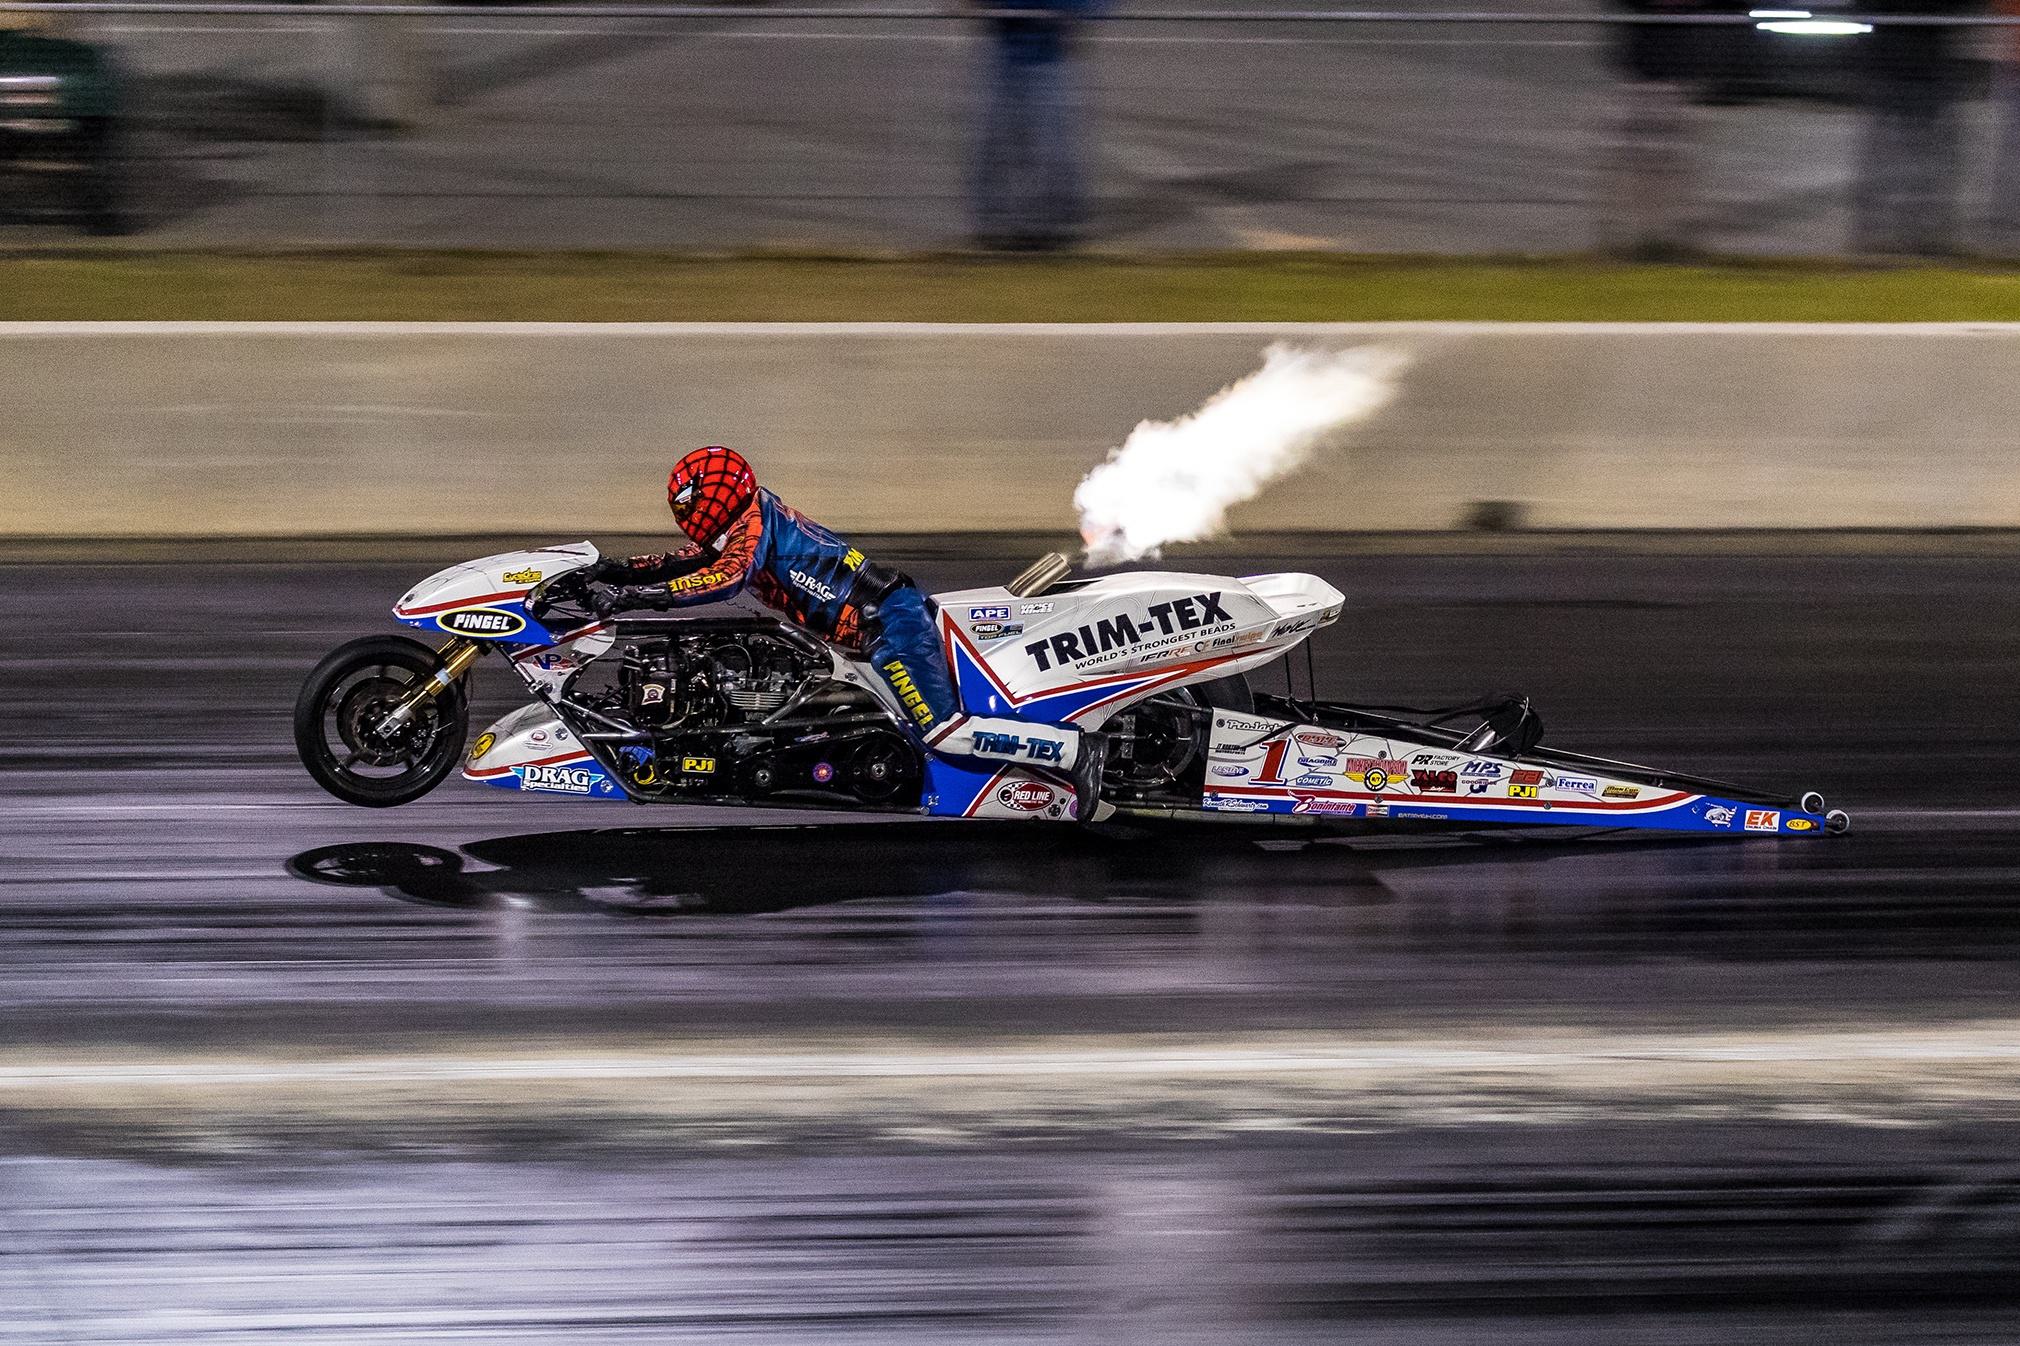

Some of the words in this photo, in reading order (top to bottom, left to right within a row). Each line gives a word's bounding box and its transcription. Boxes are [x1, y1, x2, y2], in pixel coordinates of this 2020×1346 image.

[795, 571, 831, 599] DRAG
[972, 609, 1008, 618] APE
[1025, 592, 1233, 672] TRIM-TEX
[1075, 648, 1128, 669] WORLD'S
[1131, 632, 1197, 653] STRONGEST
[1201, 623, 1236, 637] BEADS
[534, 654, 562, 671] VP
[883, 660, 935, 731] PINGEL
[973, 731, 1064, 762] TRIM-TEX
[685, 760, 714, 771] PJ1
[1249, 739, 1291, 784] 1
[1411, 755, 1433, 765] PR
[1463, 760, 1502, 774] MPS
[524, 765, 589, 786] DRAG
[1297, 777, 1332, 785] COMETIC
[524, 780, 589, 792] Specialties
[1558, 779, 1595, 789] Ferrea
[1014, 791, 1031, 800] RED
[1032, 791, 1051, 801] LINE
[1509, 785, 1538, 798] PJ1
[1746, 812, 1778, 826] EK
